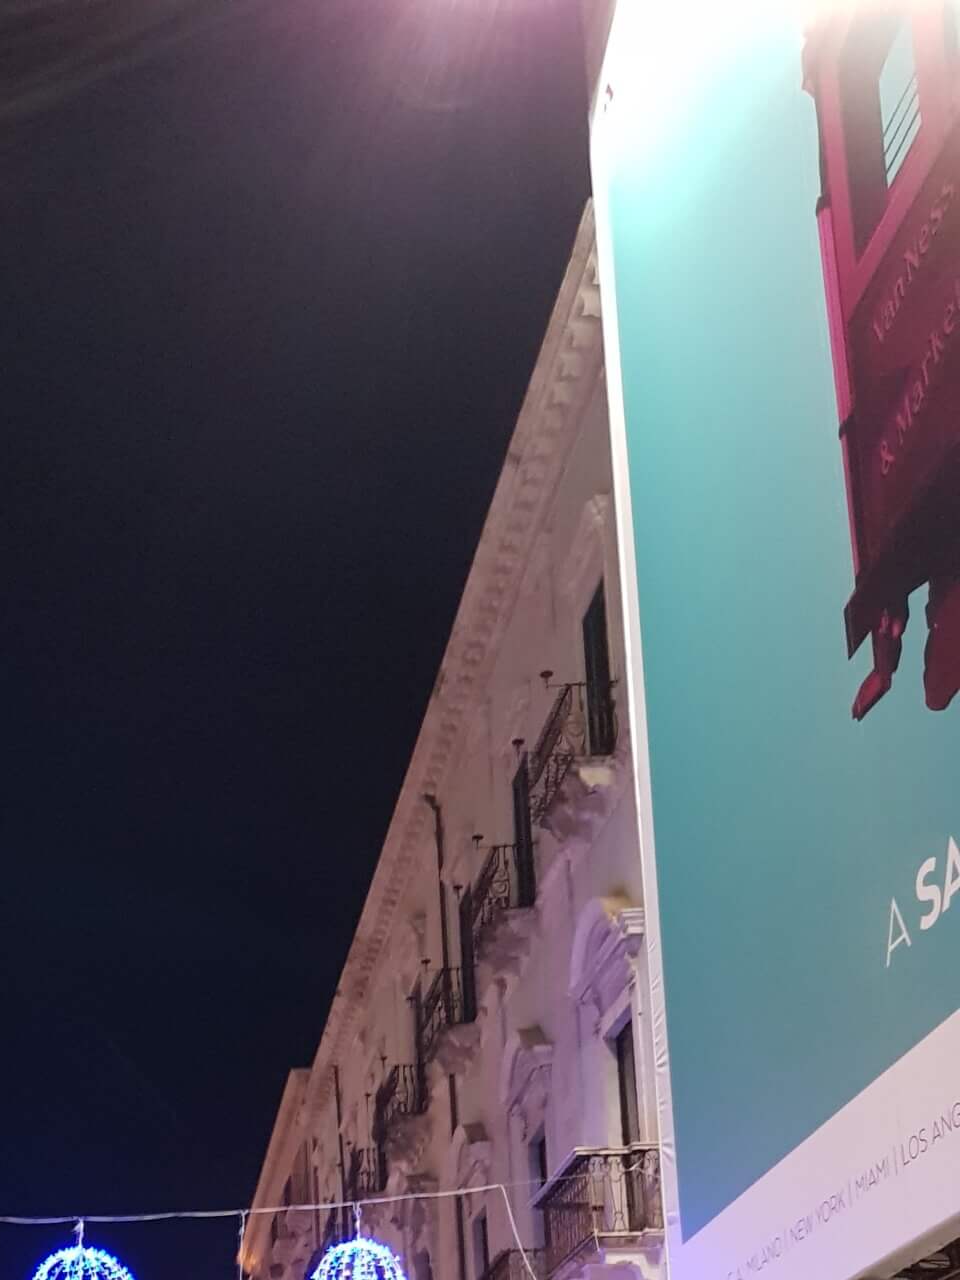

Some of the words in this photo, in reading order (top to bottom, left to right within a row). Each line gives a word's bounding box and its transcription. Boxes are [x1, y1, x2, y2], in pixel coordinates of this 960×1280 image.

[886, 896, 912, 968] A
[814, 1188, 846, 1225] YORK
[855, 1155, 889, 1198] MIAMI
[900, 1127, 929, 1166] LOS
